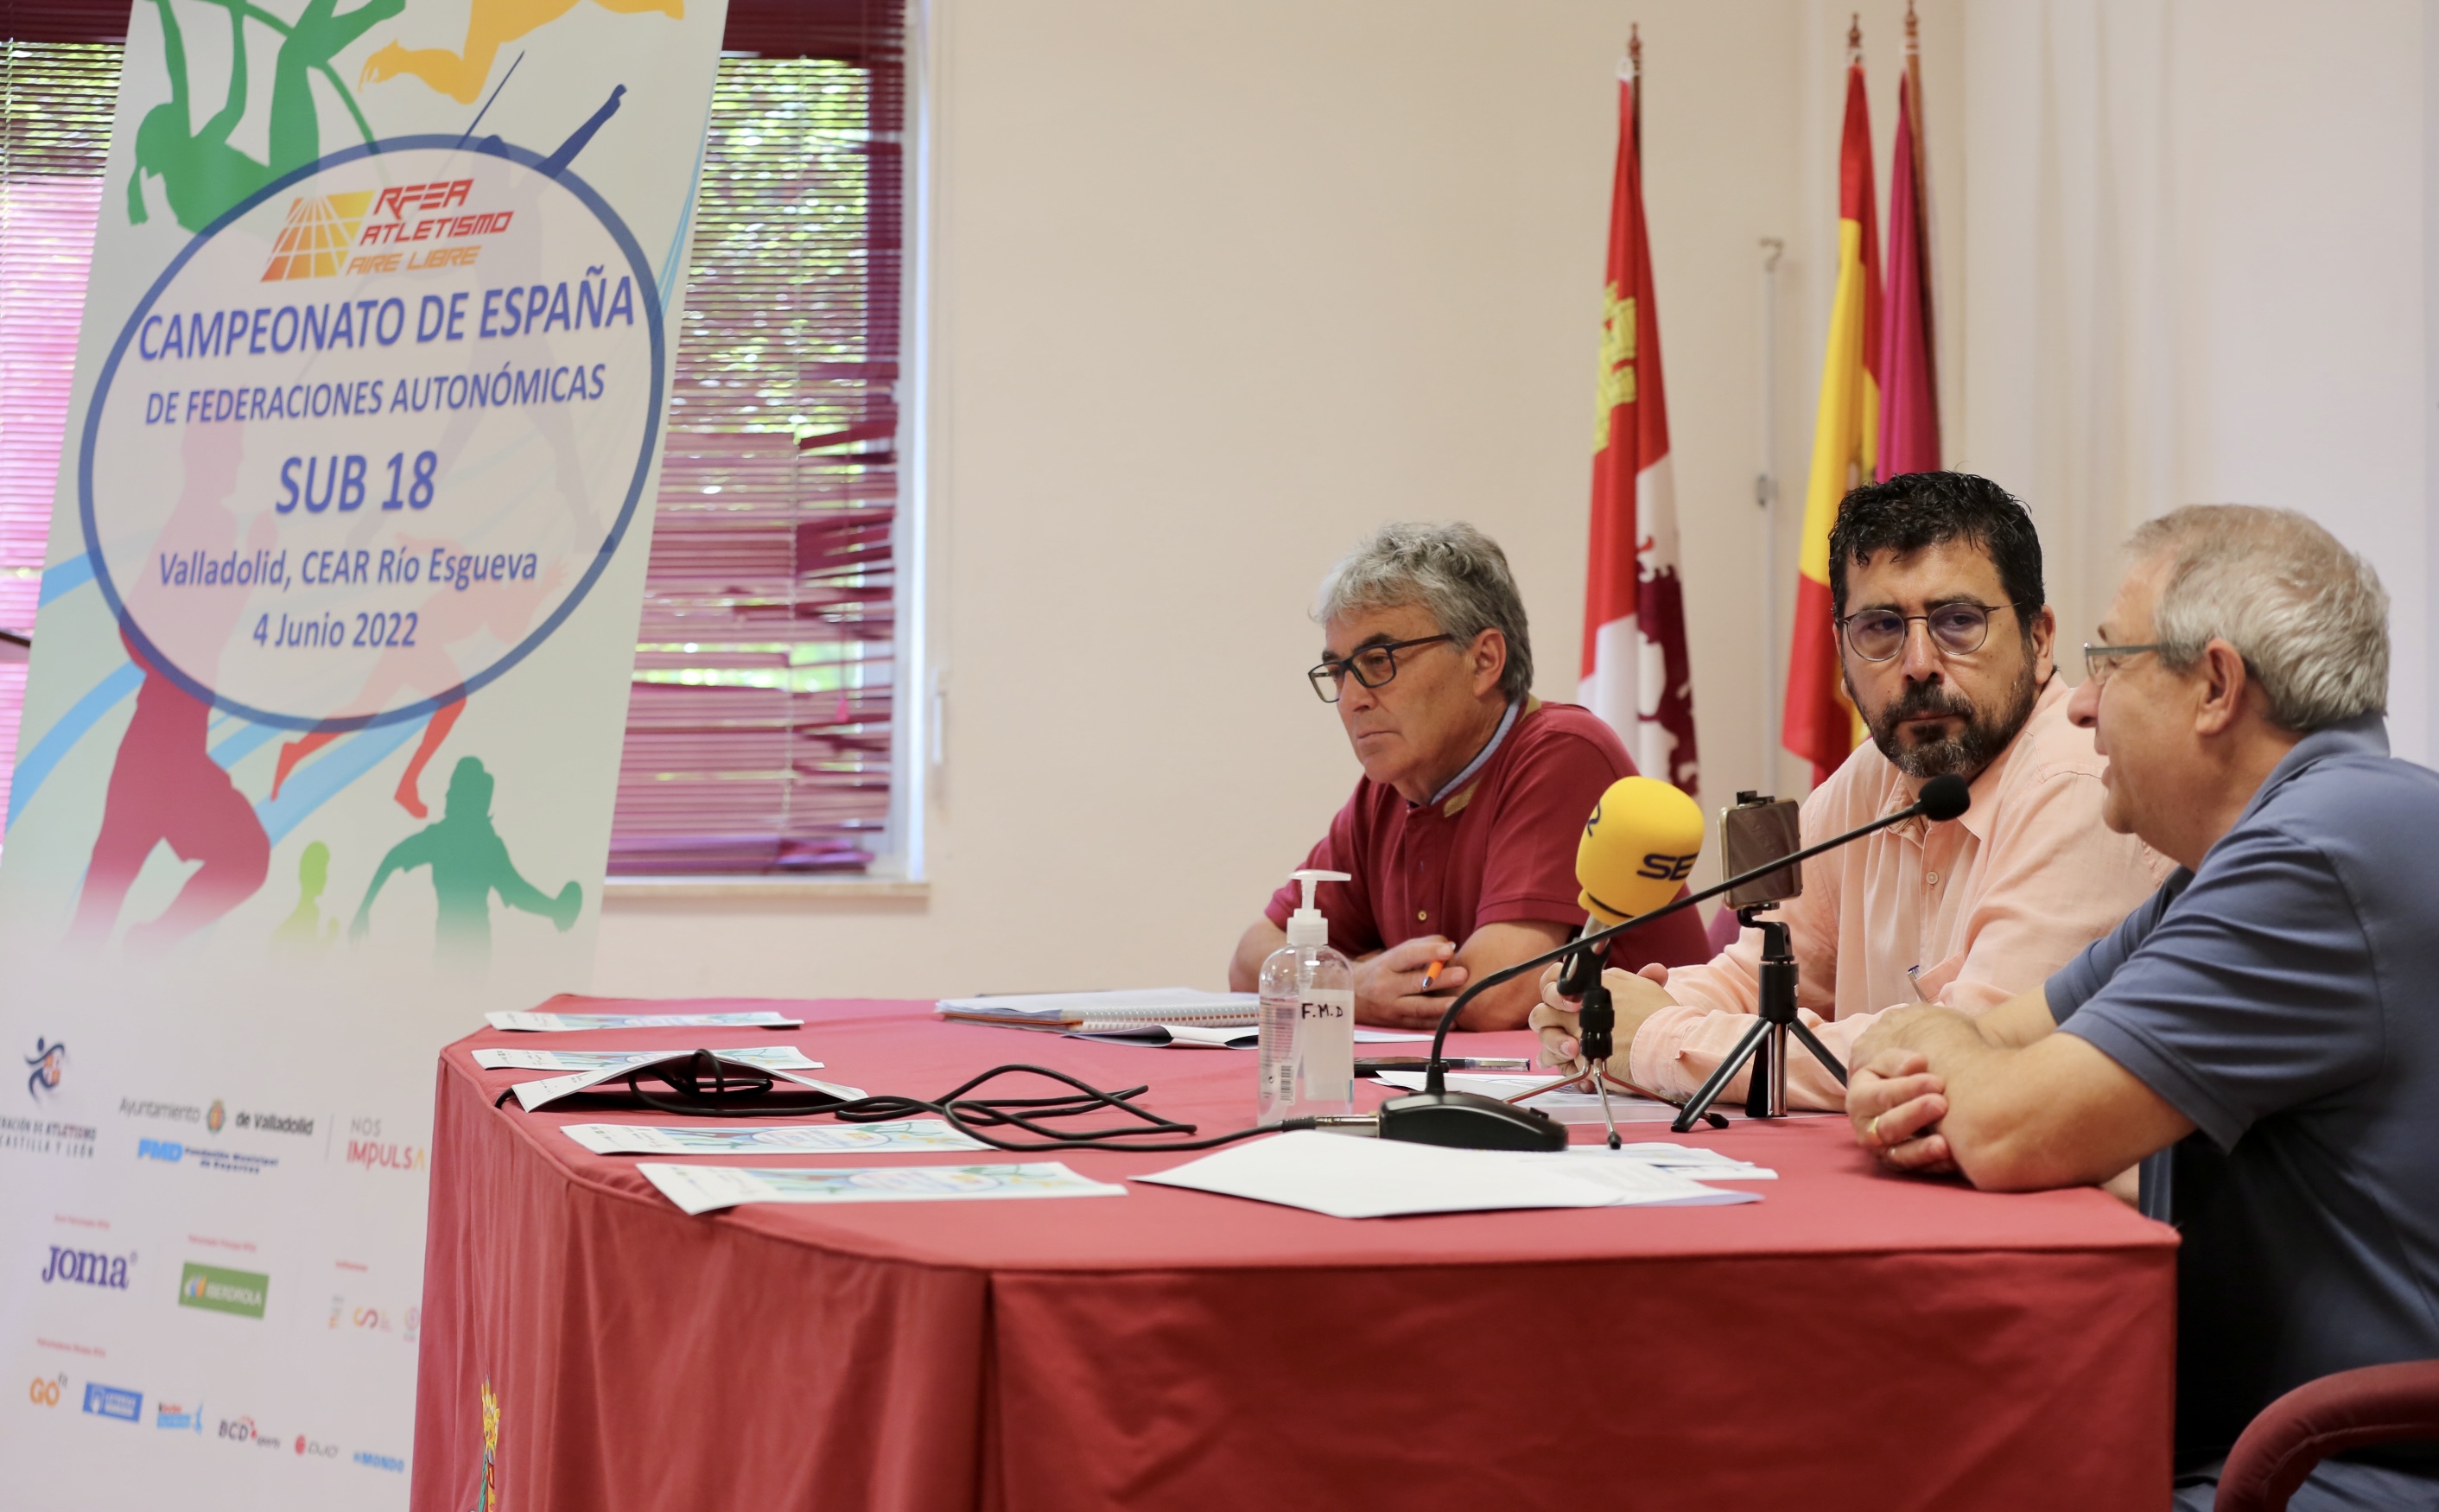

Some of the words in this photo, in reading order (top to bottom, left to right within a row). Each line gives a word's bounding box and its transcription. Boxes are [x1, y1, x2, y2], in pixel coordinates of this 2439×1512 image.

[373, 178, 474, 220] RFEA
[359, 211, 515, 247] ATLETISMO
[346, 252, 403, 276] AIRE
[406, 245, 483, 271] LIBRE
[139, 296, 404, 362] CAMPEONATO
[416, 291, 468, 344] DE
[480, 264, 635, 339] ESPAÑA
[145, 391, 178, 425] DE
[187, 379, 383, 424] FEDERACIONES
[390, 360, 607, 413] AUTONÓMICAS
[276, 454, 367, 515] SUB
[381, 449, 438, 511] 18
[160, 549, 293, 593] Valladolid,
[302, 549, 370, 586] CEAR
[378, 545, 421, 584] Río
[428, 546, 537, 591] Esgueva
[252, 613, 269, 648] 4
[274, 612, 344, 648] Junio
[352, 611, 418, 647] 2022
[119, 1097, 201, 1124] Ayuntamiento
[235, 1109, 251, 1128] de
[254, 1113, 314, 1136] Valladolid
[350, 1116, 382, 1138] NOS
[138, 1138, 184, 1162] FMD
[29, 1376, 60, 1407] GO
[219, 1419, 249, 1442] BCD
